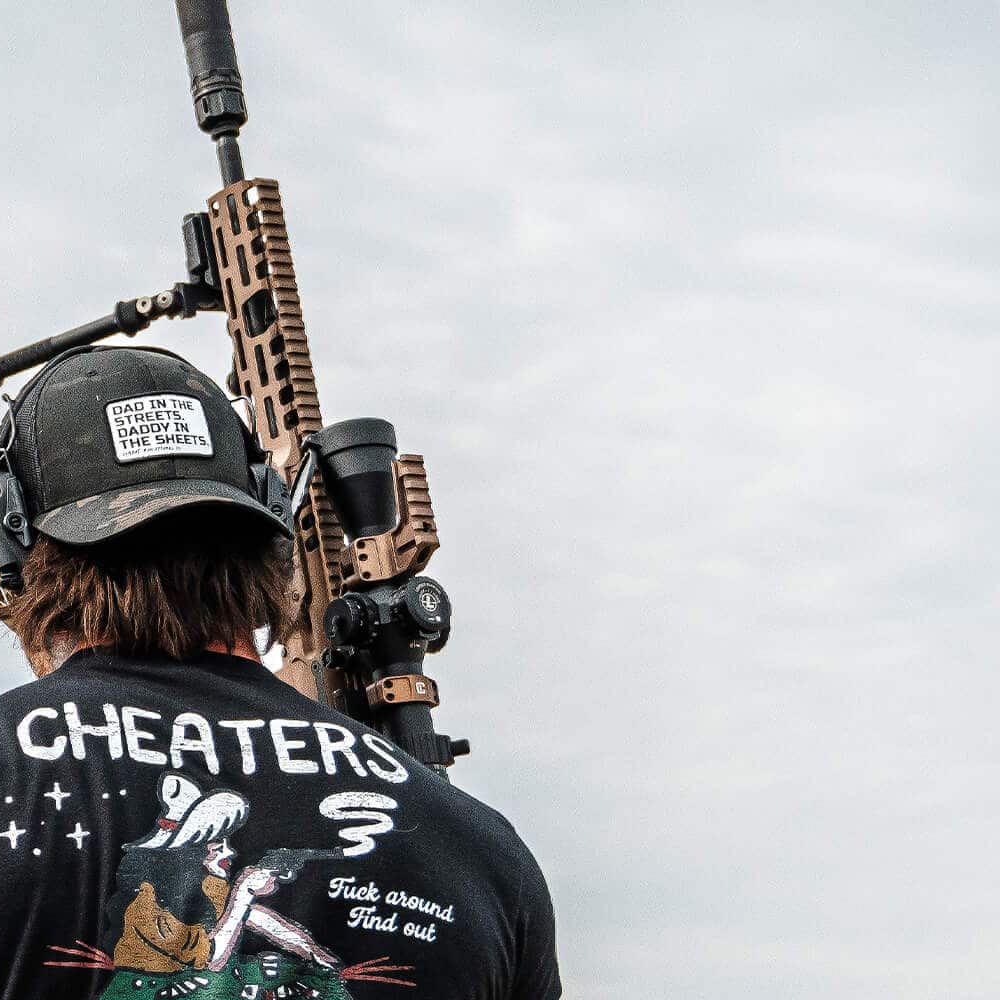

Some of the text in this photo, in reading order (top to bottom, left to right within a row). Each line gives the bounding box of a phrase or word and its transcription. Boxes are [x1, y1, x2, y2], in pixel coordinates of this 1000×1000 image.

[112, 399, 194, 415] DAD IN THE
[114, 410, 185, 427] STREETS.
[117, 422, 189, 438] DADDY IN
[119, 436, 151, 449] THE
[16, 702, 409, 784] CHEATERS
[328, 876, 454, 922] Fuck around
[347, 906, 437, 942] Find out
